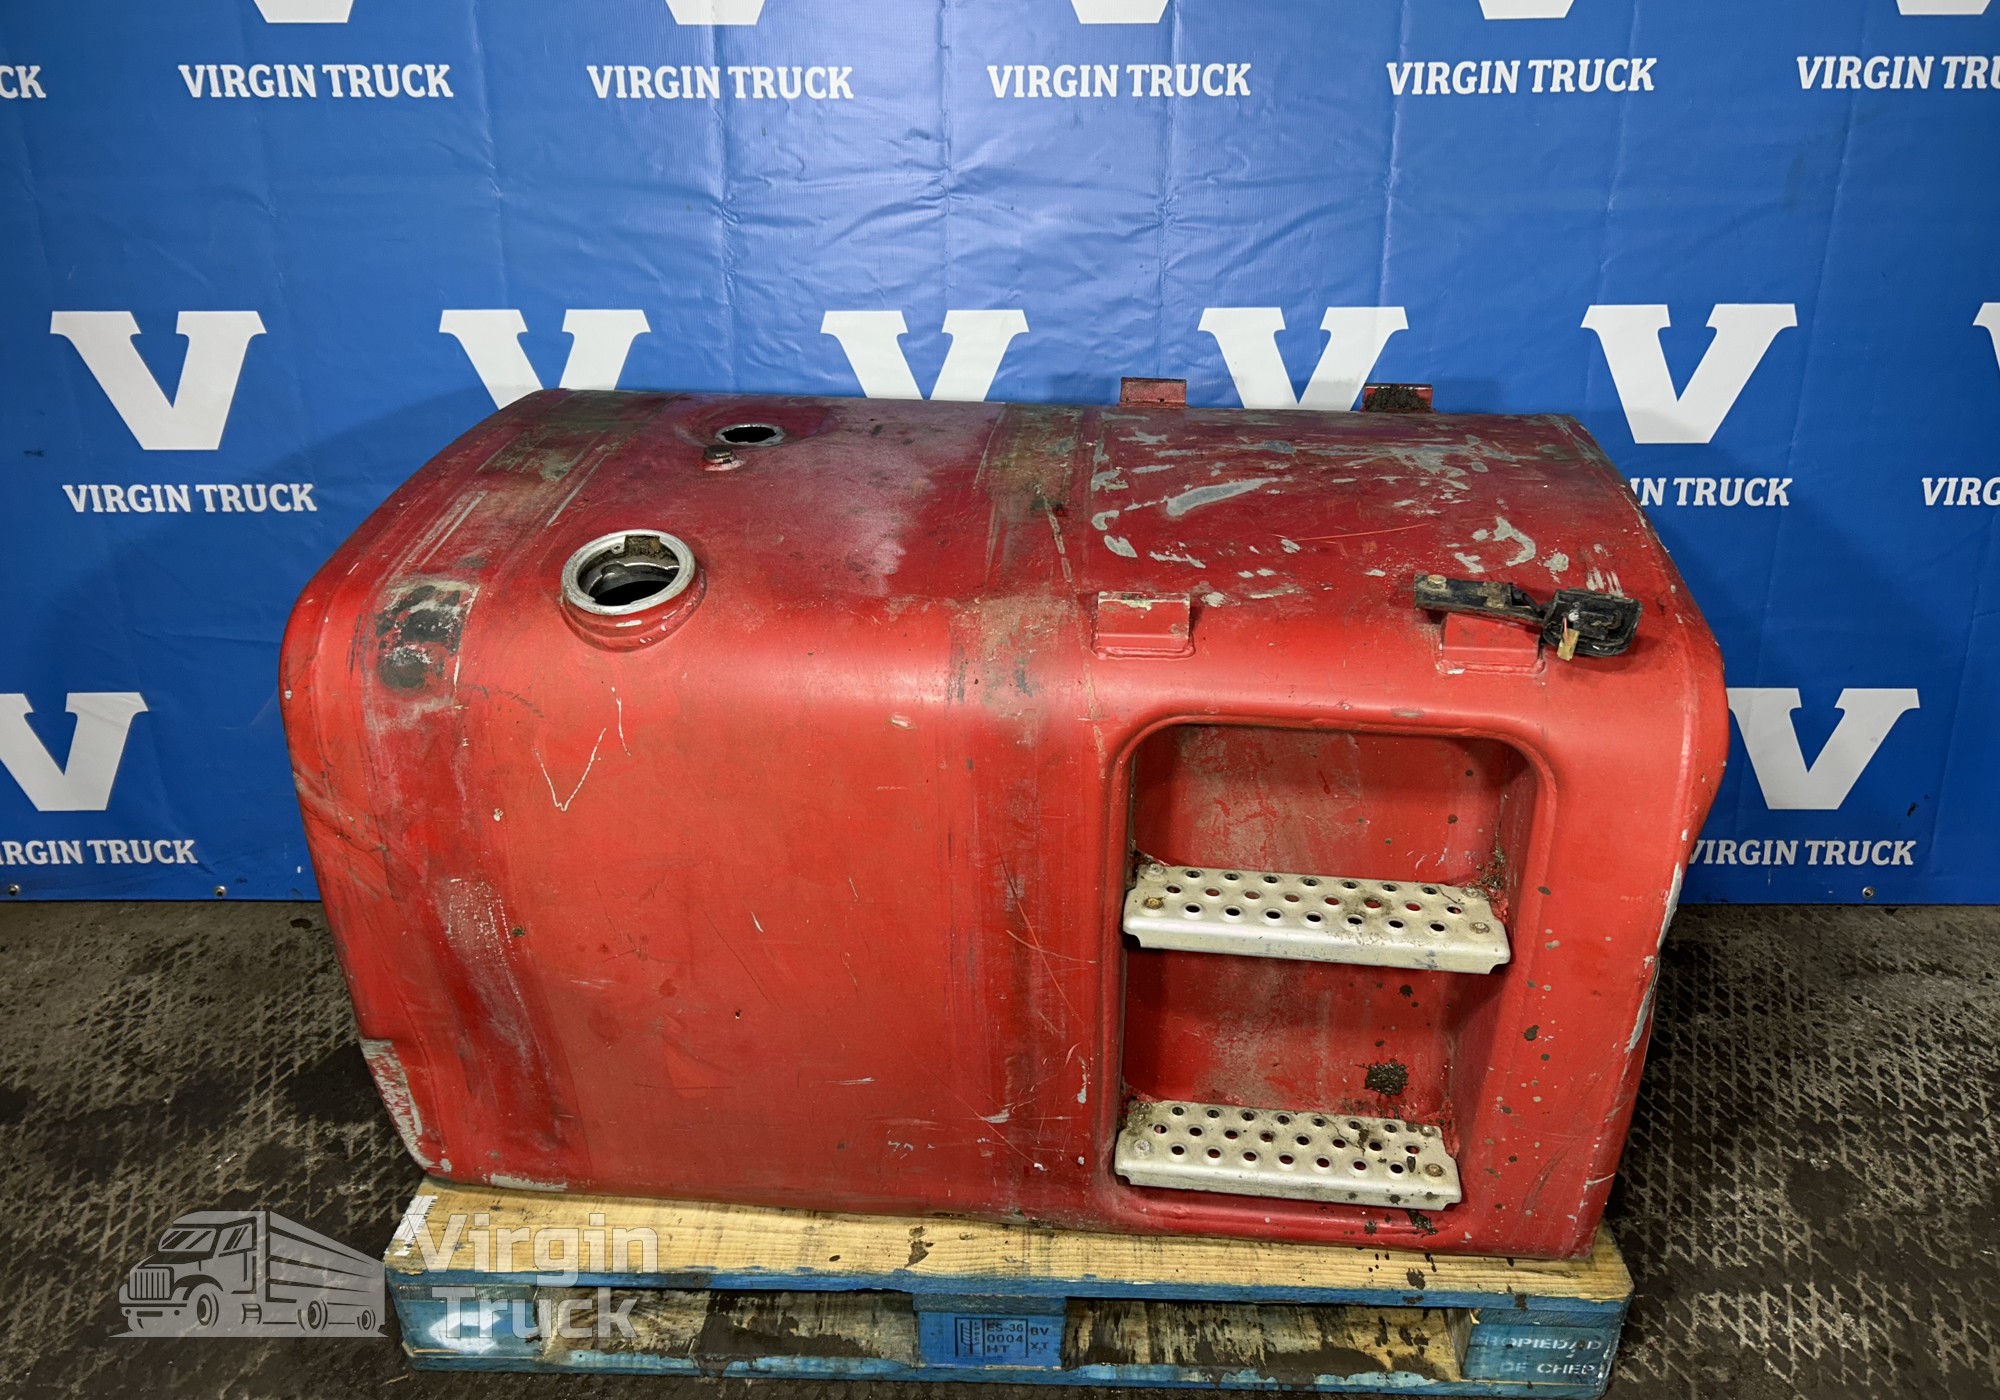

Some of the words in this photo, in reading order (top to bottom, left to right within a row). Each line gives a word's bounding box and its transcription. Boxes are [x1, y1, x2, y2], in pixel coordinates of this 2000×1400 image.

[178, 64, 317, 98] VIRGIN
[322, 64, 454, 98] TRUCK
[587, 66, 720, 99] VIRGIN
[728, 66, 854, 99] TRUCK
[987, 64, 1118, 98] VIRGIN
[1126, 64, 1251, 98] TRUCK
[1386, 60, 1520, 95] VIRGIN
[1528, 58, 1657, 93] TRUCK
[1797, 56, 1934, 89] VIRGIN
[50, 311, 266, 450] V
[1581, 304, 1797, 443] V
[63, 485, 191, 512] VIRGIN
[196, 484, 317, 511] TRUCK
[1673, 478, 1792, 506] TRUCK
[1723, 688, 1920, 809] V
[87, 840, 197, 864] TRUCK
[1804, 840, 1916, 865] TRUCK
[986, 1334, 1024, 1343] 0004
[986, 1345, 1010, 1353] HT
